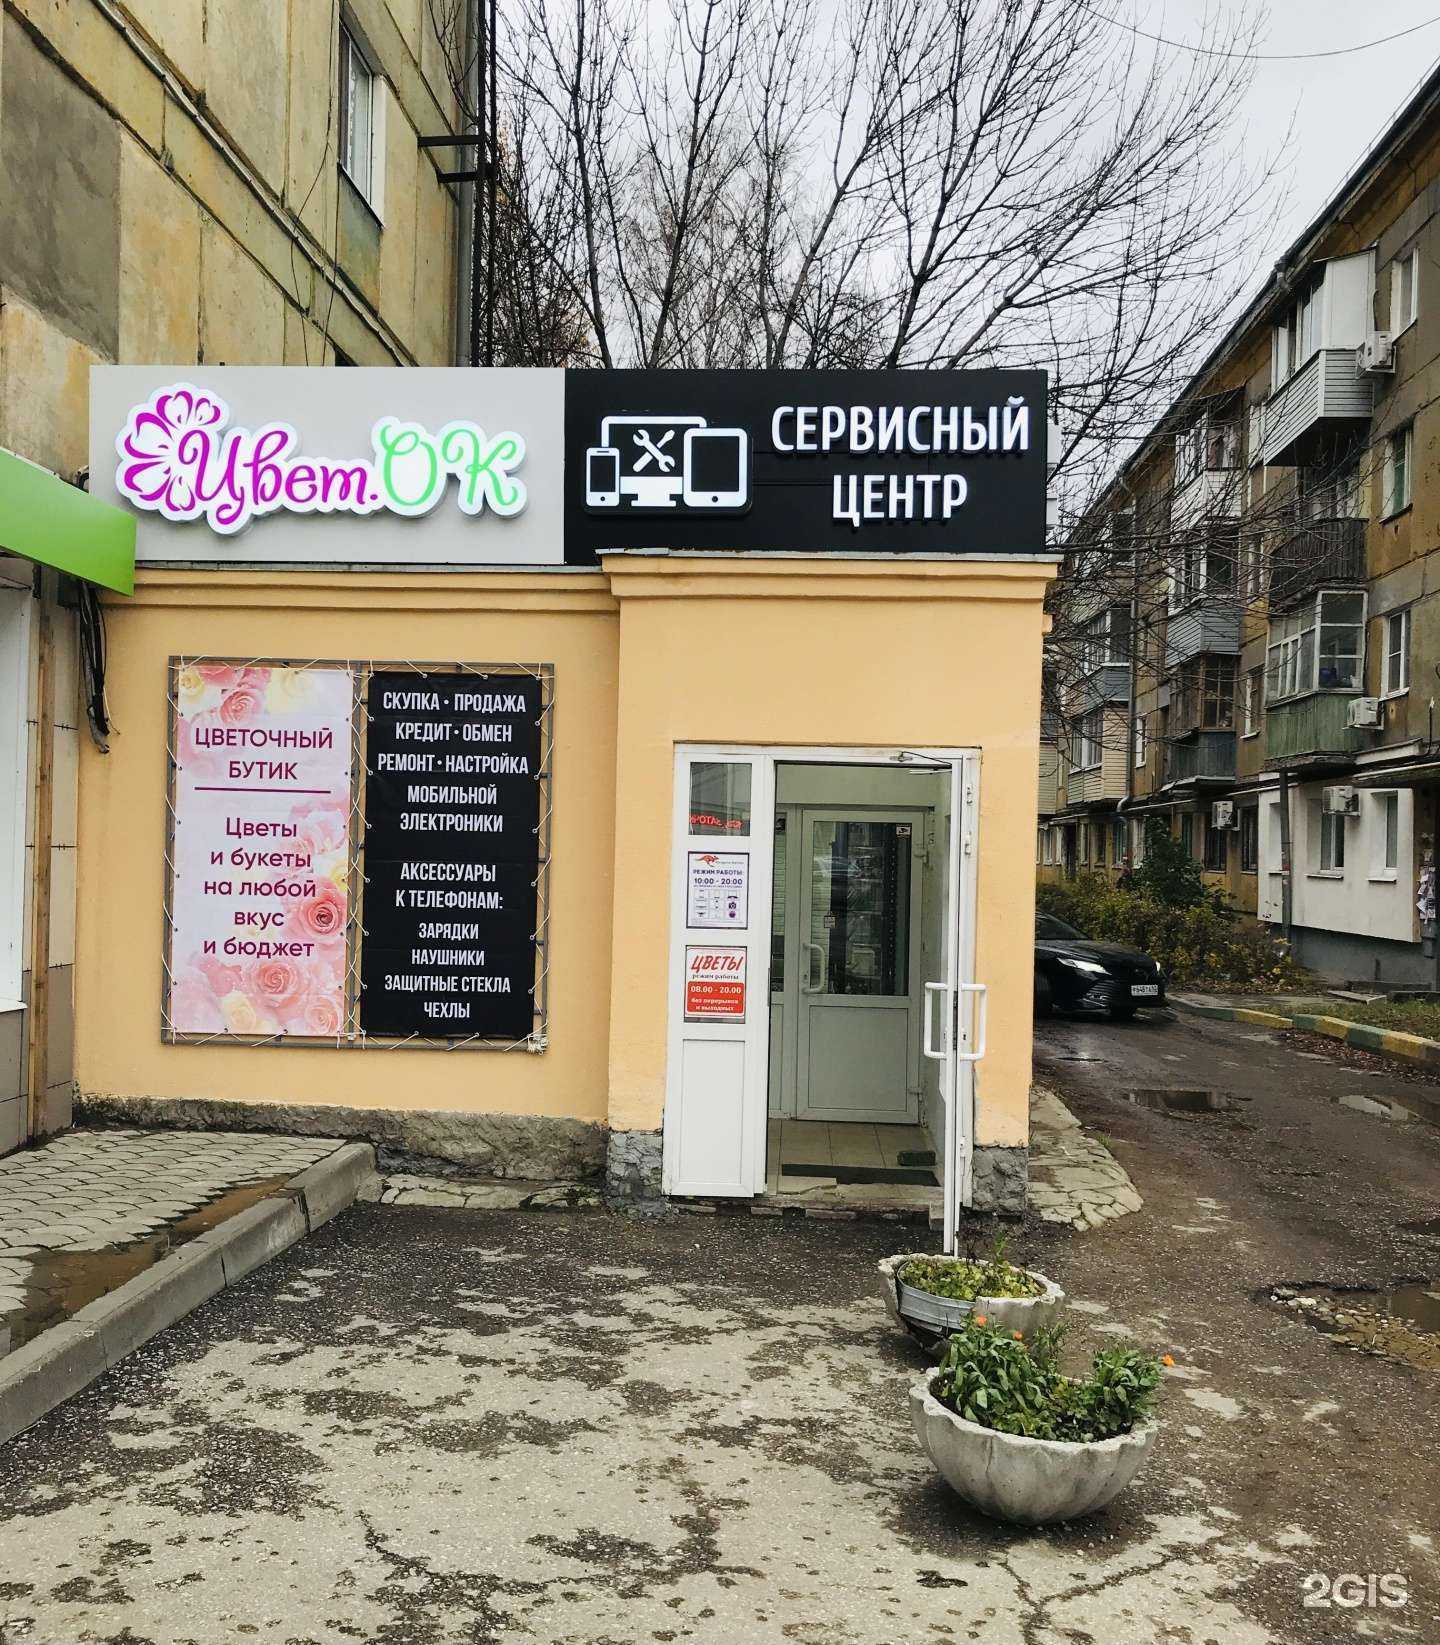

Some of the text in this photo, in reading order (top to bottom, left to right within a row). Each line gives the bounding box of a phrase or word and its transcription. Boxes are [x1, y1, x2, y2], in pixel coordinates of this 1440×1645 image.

[771, 396, 1029, 453] СЕРВИСНЫЙ
[832, 473, 968, 527] ЦЕНТР
[382, 691, 527, 713] СКУПКА ПРОДАЖА
[195, 727, 333, 749] ЦВЕТОЧНЫЙ
[395, 721, 513, 743] КРЕДИТ ОБМЕН
[228, 760, 298, 780] БУТИК
[377, 752, 529, 775] РЕМОНТ НАСТРОЙКА
[407, 783, 498, 805] МОБИЛЬНОЙ
[225, 817, 298, 839] Цветы
[399, 812, 504, 833] ЭЛЕКТРОНИКИ
[210, 847, 312, 871] и букеты
[400, 862, 497, 882] АКСЕССУАРЫ
[204, 879, 317, 897] на любой
[395, 889, 504, 910] К ТЕЛЕФОНАМ:
[233, 911, 285, 931] вкус
[418, 922, 480, 941] ЗАРЯДКИ
[203, 936, 315, 959] и бюджет
[411, 949, 486, 967] НАУШНИКИ
[690, 955, 744, 973] ЦВЕТЫ
[384, 974, 511, 993] ЗАЩИТНЫЕ СТЕКЛА
[423, 1002, 471, 1019] ЧЕХЛЫ
